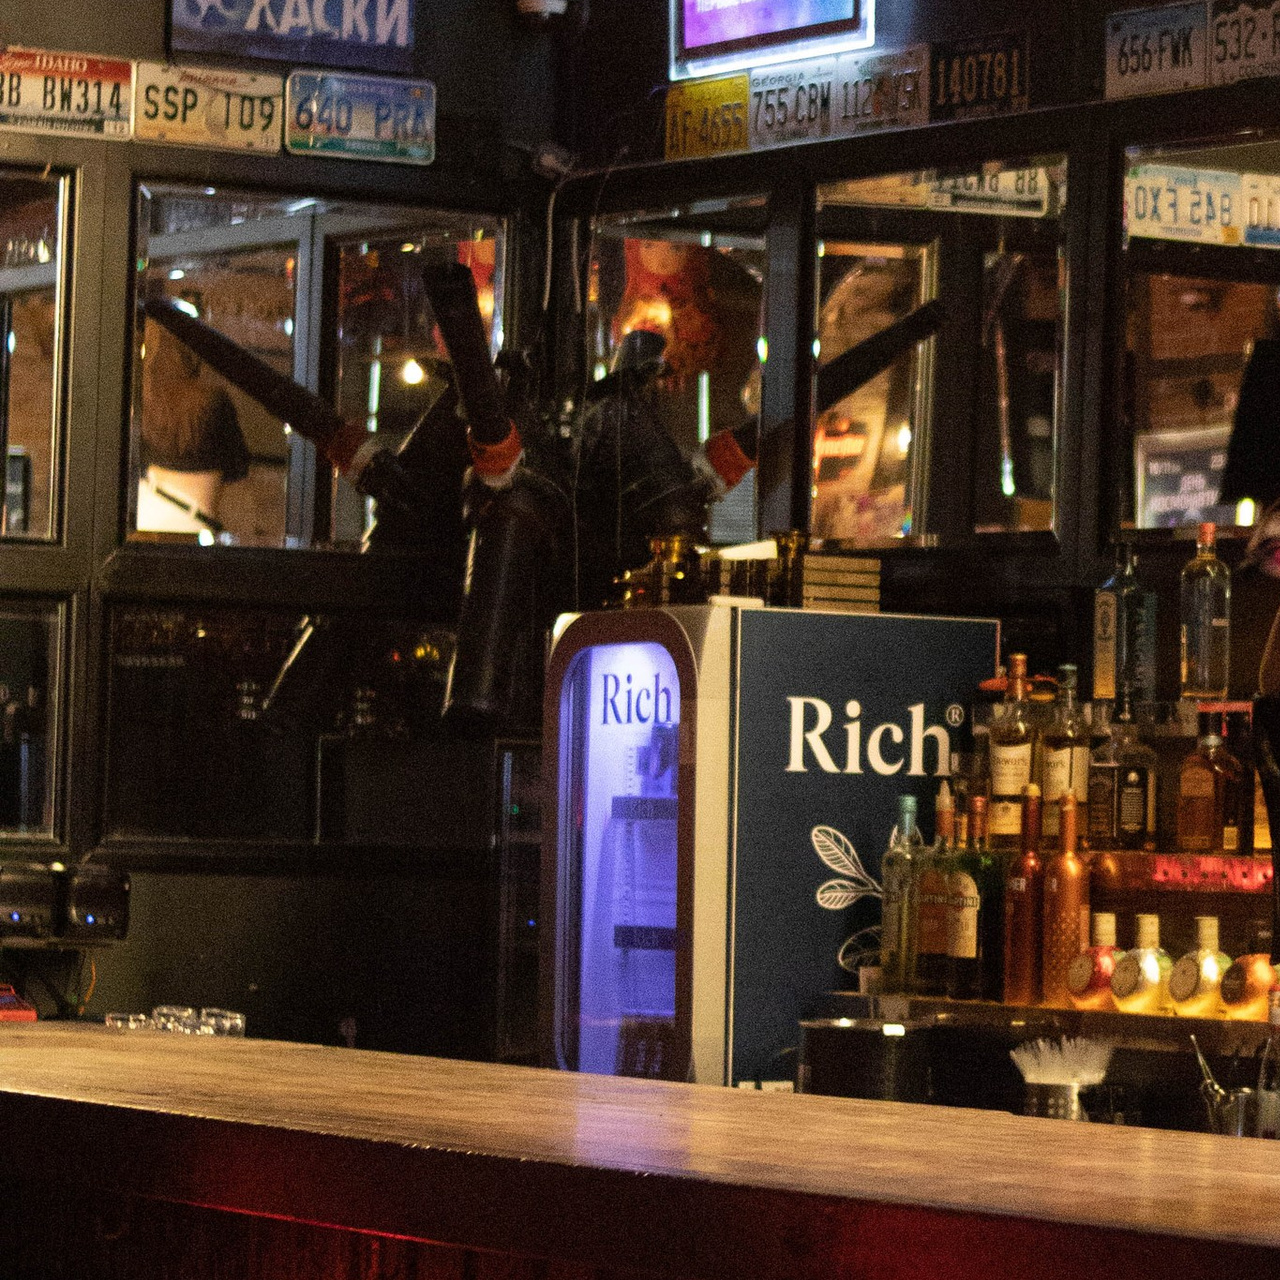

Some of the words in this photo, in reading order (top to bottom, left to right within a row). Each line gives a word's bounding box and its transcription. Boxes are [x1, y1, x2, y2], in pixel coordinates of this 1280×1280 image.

[35, 54, 89, 74] IDAHO
[751, 72, 804, 89] GEORGIA
[42, 74, 122, 118] BW314
[143, 83, 199, 124] SSP
[222, 90, 275, 132] 109
[752, 86, 789, 135] 755
[601, 673, 673, 726] Rich
